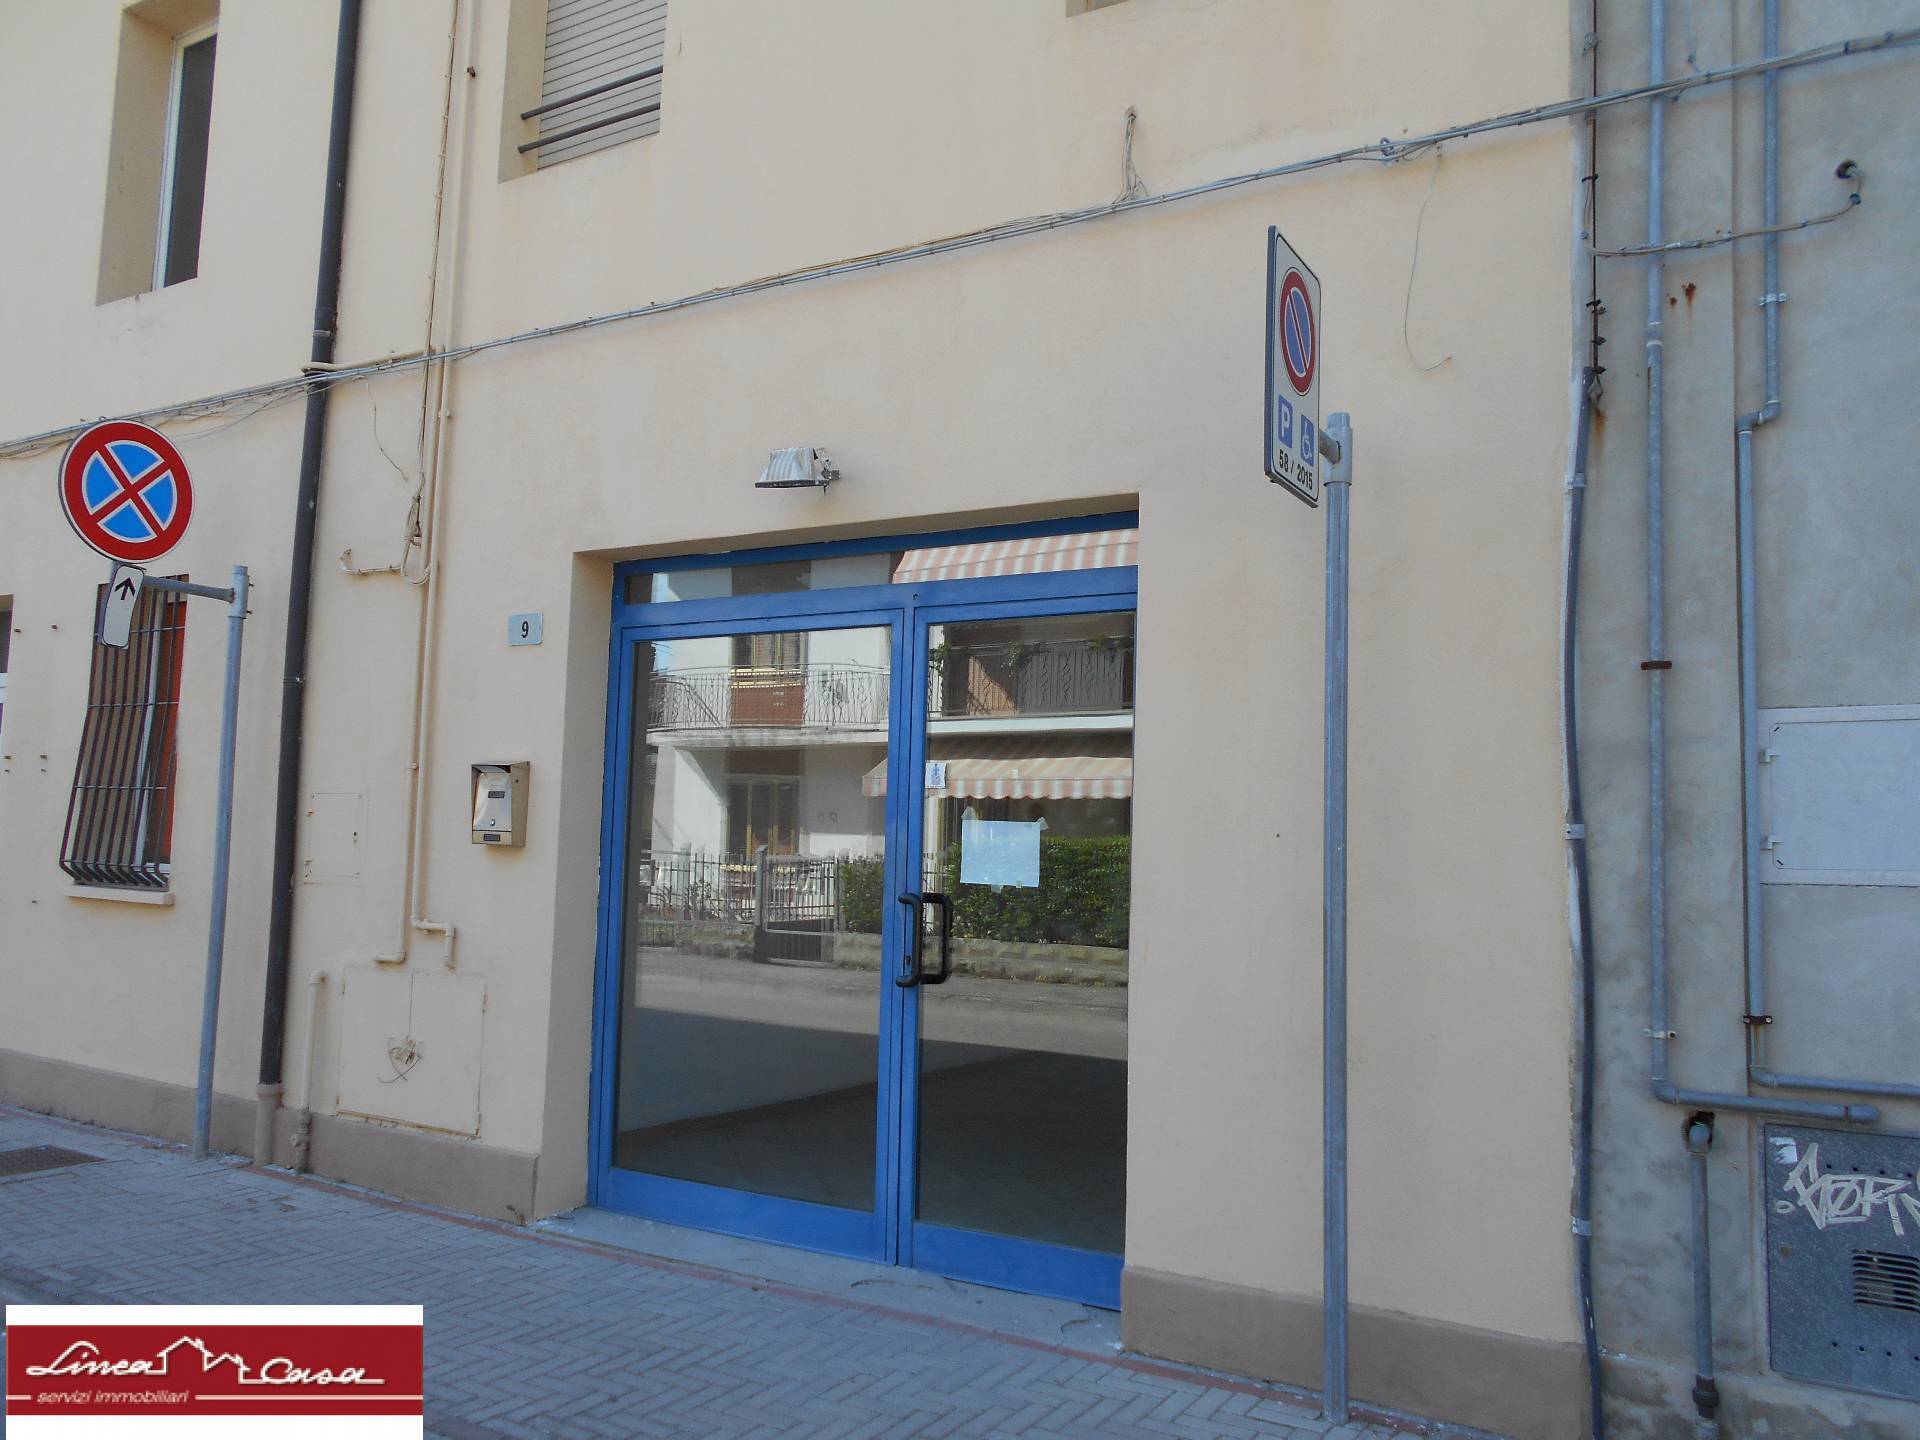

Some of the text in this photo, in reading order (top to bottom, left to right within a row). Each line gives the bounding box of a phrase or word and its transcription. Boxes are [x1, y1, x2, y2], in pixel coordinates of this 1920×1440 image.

[1281, 403, 1291, 438] P
[1279, 448, 1289, 473] 58
[1297, 463, 1313, 491] 2015
[521, 620, 529, 639] 9
